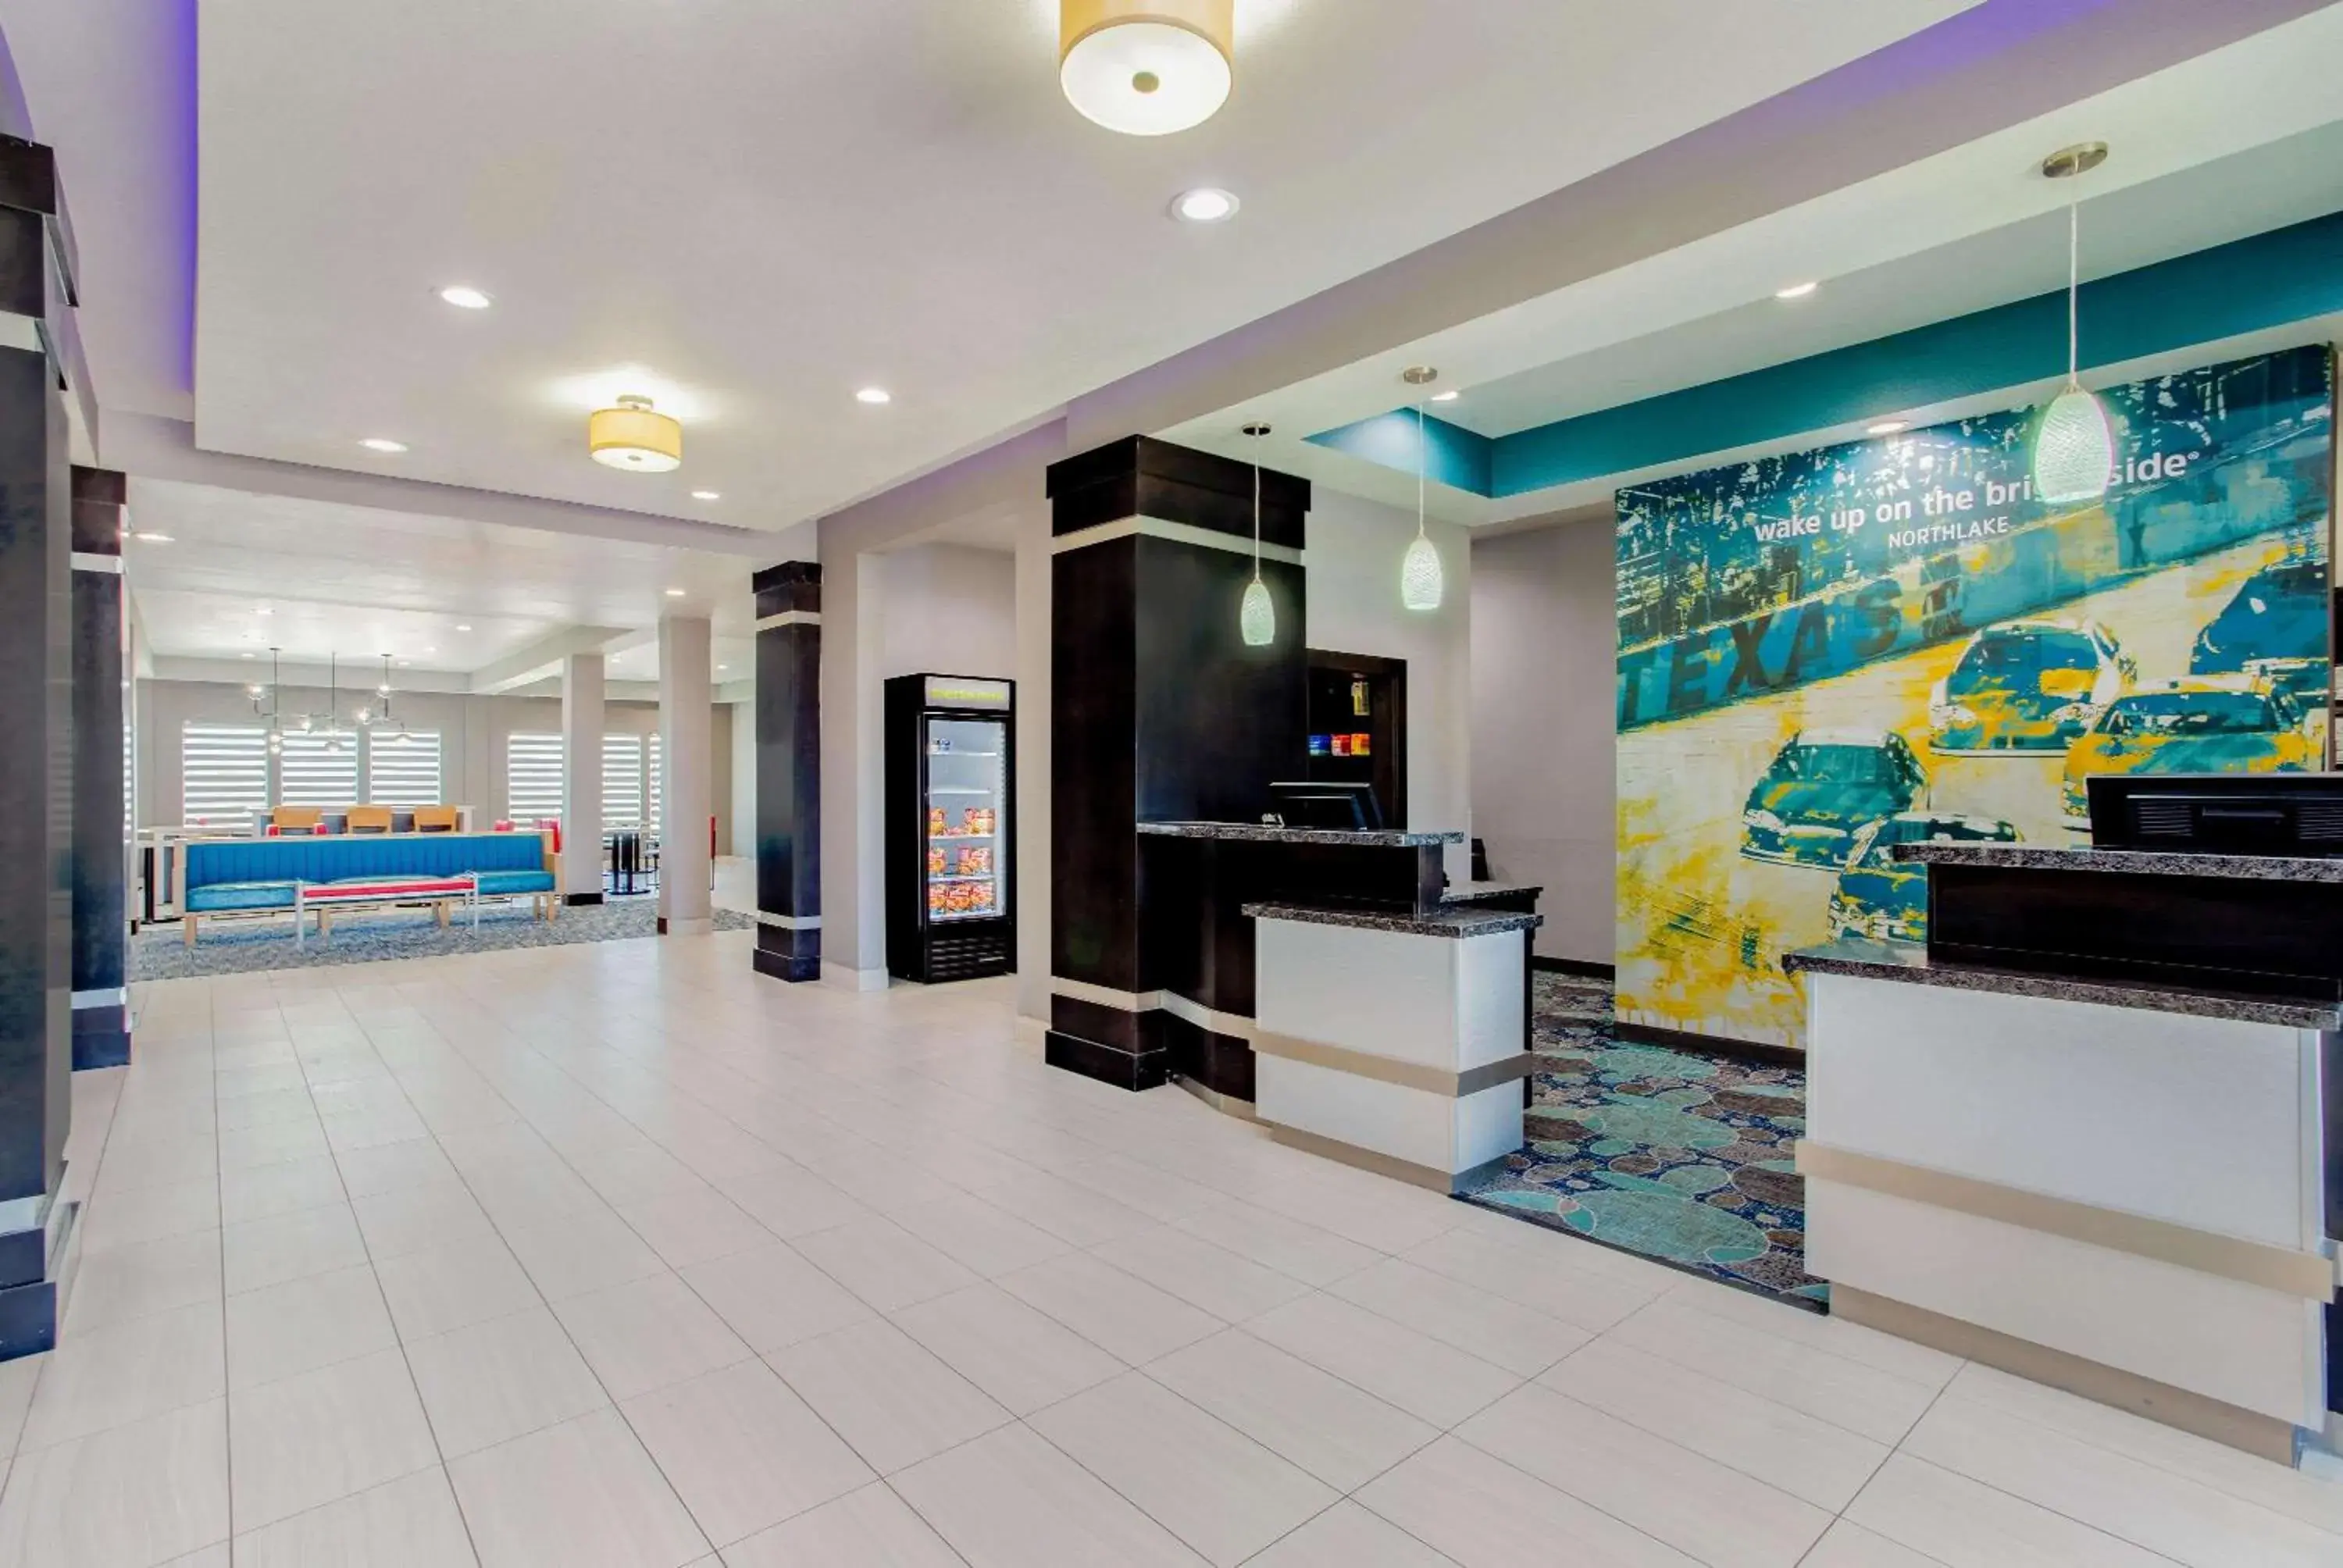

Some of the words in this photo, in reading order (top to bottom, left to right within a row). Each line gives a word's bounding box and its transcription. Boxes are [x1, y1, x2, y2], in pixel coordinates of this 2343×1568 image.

[1754, 512, 1821, 542] wake
[1830, 507, 1865, 535] up
[1875, 499, 1912, 523] on
[1923, 485, 1974, 517] the
[1888, 515, 2010, 548] NORTHLAKE
